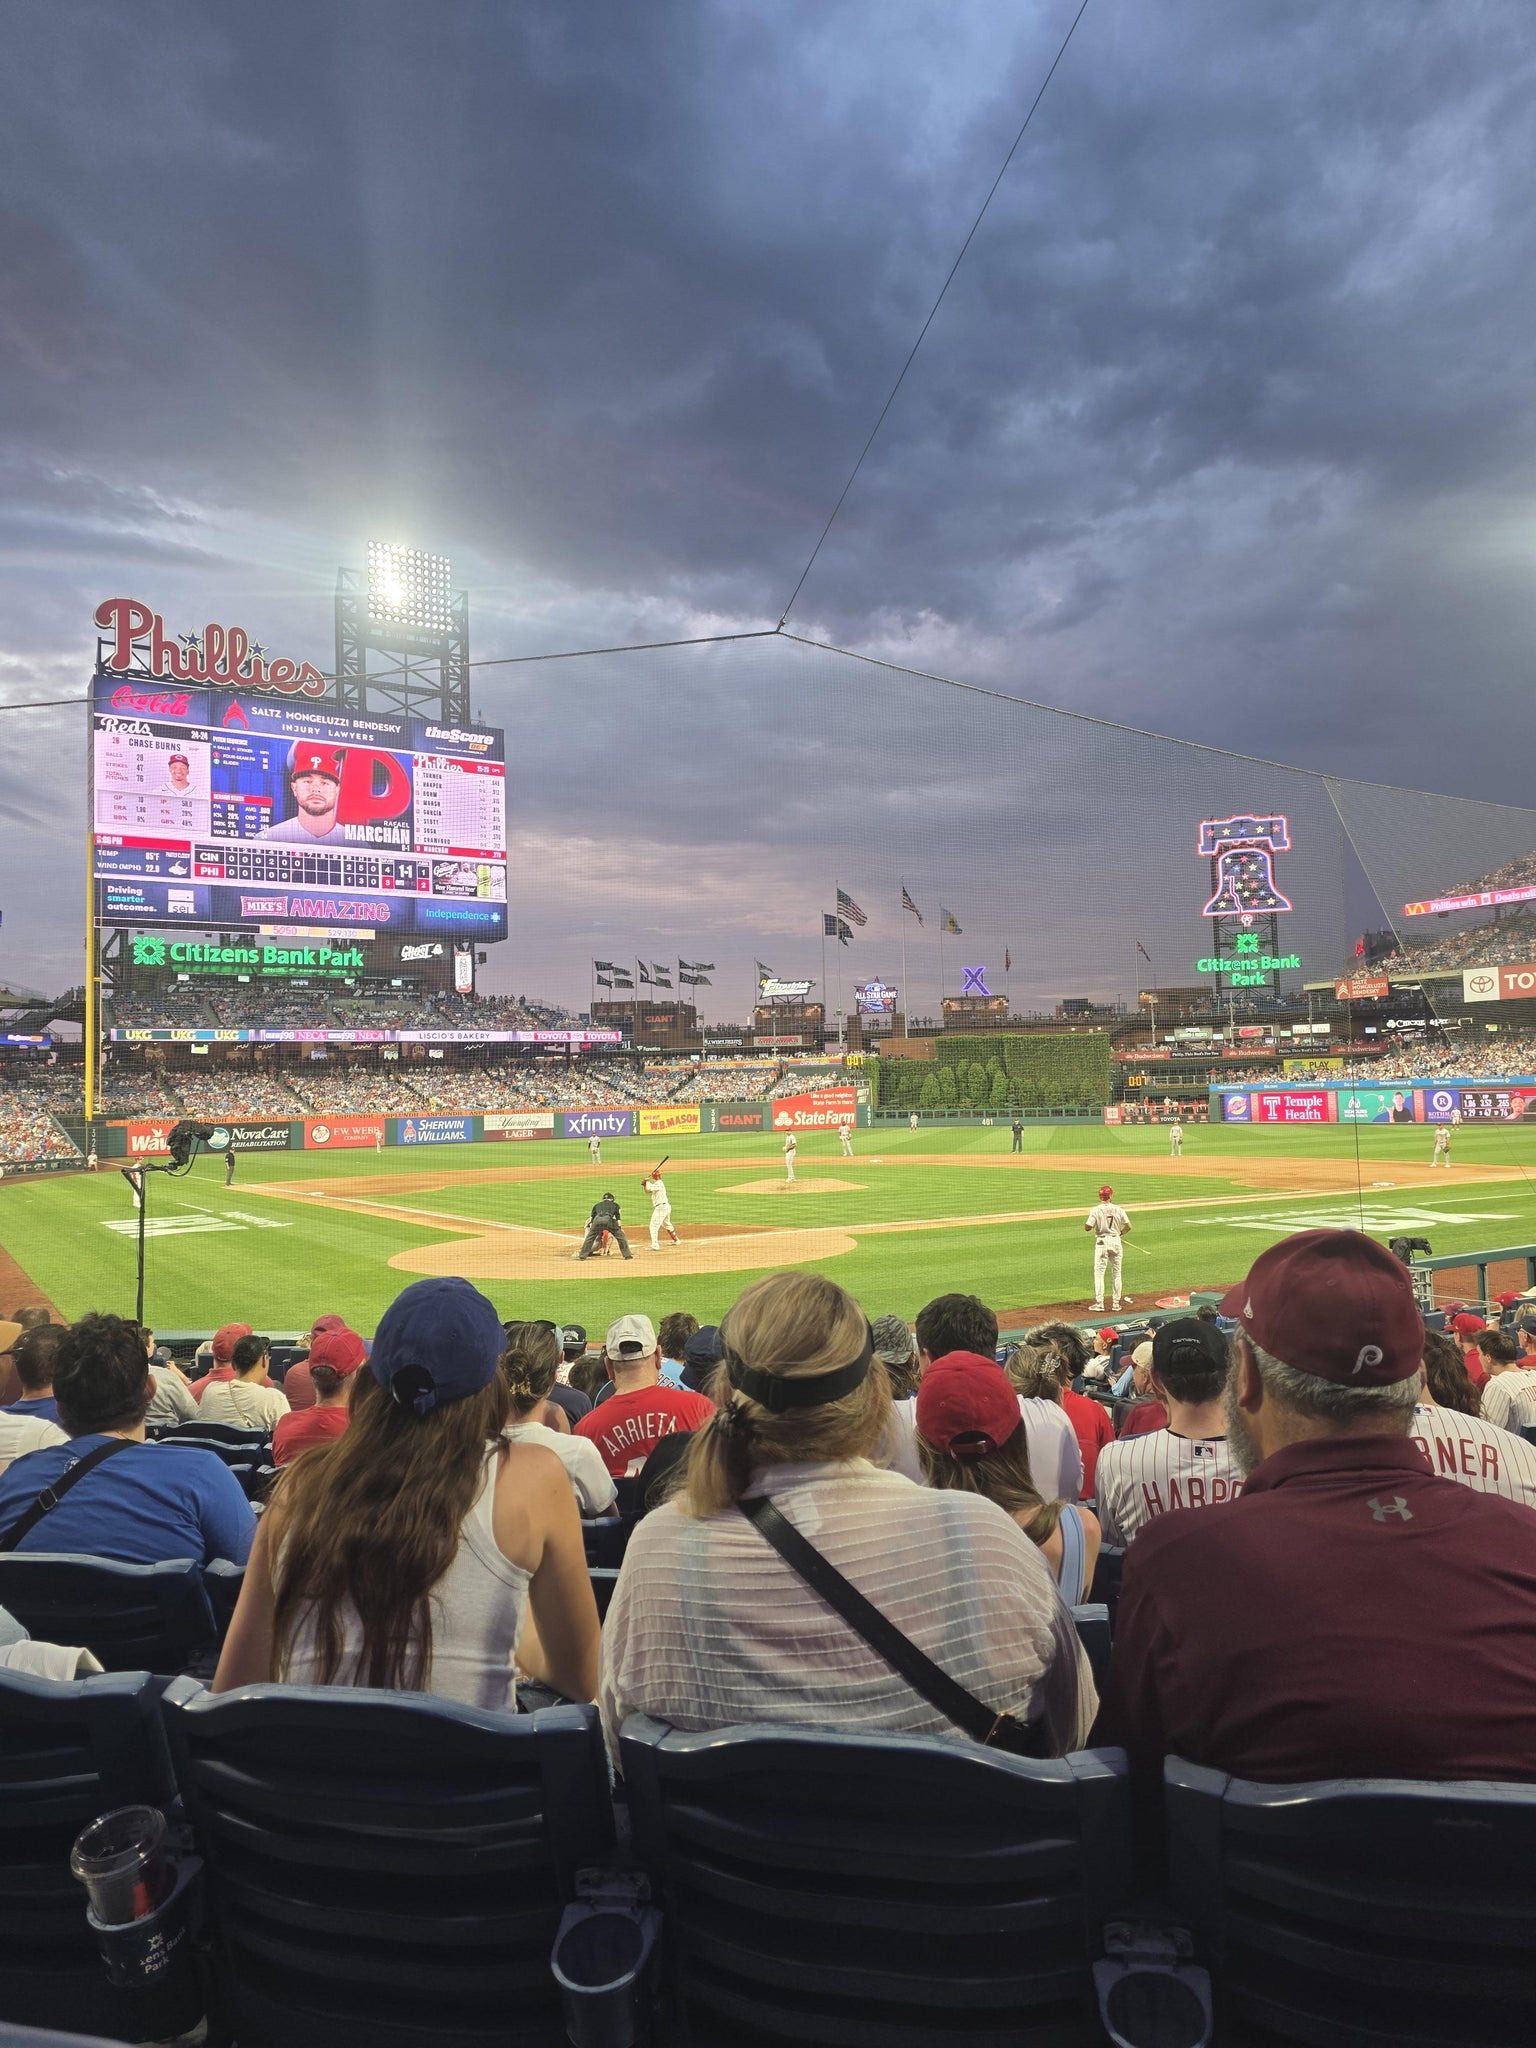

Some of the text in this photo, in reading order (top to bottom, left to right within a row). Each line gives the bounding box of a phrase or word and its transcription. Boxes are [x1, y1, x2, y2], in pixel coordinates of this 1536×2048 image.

[94, 597, 326, 697] Phillies
[251, 706, 401, 734] SALTZ MONGELUZZI BENDESKY
[100, 717, 154, 738] Reds
[282, 724, 374, 742] INJURY LAWYERS
[425, 726, 494, 745] theScore
[128, 738, 181, 752] CHASE BURNS
[414, 753, 464, 772] Phillies
[136, 774, 144, 782] 76
[344, 824, 410, 845] MARCHÁN
[200, 852, 219, 862] CIN
[97, 862, 118, 870] WIND
[200, 866, 219, 876] PHI
[399, 865, 412, 878] 1-1
[107, 886, 143, 896] Driving
[107, 904, 158, 912] outcomes.
[1430, 900, 1460, 912] Phillies
[1461, 898, 1477, 907] win
[1494, 892, 1520, 902] Deals
[247, 898, 391, 922] MIKE'S AMAZING
[426, 908, 489, 921] Independence
[170, 942, 364, 967] Citizens Bank Park
[401, 944, 436, 961] GHOST
[1197, 954, 1300, 972] Citizens Bank
[1231, 972, 1266, 986] Park
[856, 990, 898, 999] ALL STAR GAME
[644, 1015, 674, 1023] GIANT
[125, 1030, 152, 1040] UKG
[170, 1030, 196, 1040] UKG
[214, 1030, 240, 1040] UKG
[298, 1031, 327, 1040] NECA
[358, 1031, 384, 1040] NECA
[1309, 1061, 1329, 1069] PLAY
[1284, 1095, 1323, 1107] Temple
[1439, 1098, 1447, 1106] R
[719, 1114, 762, 1125] GIANT
[1285, 1109, 1321, 1120] Health
[418, 1120, 464, 1130] SHERWIN
[498, 1116, 541, 1128] Yuengling
[569, 1114, 626, 1134] xfinity
[230, 1127, 289, 1140] NovaCare
[352, 1126, 380, 1135] WEBB
[505, 1130, 534, 1138] LAGER
[1107, 1216, 1114, 1230] 7
[602, 1412, 678, 1457] ARRIETA
[144, 1958, 170, 1975] Park
